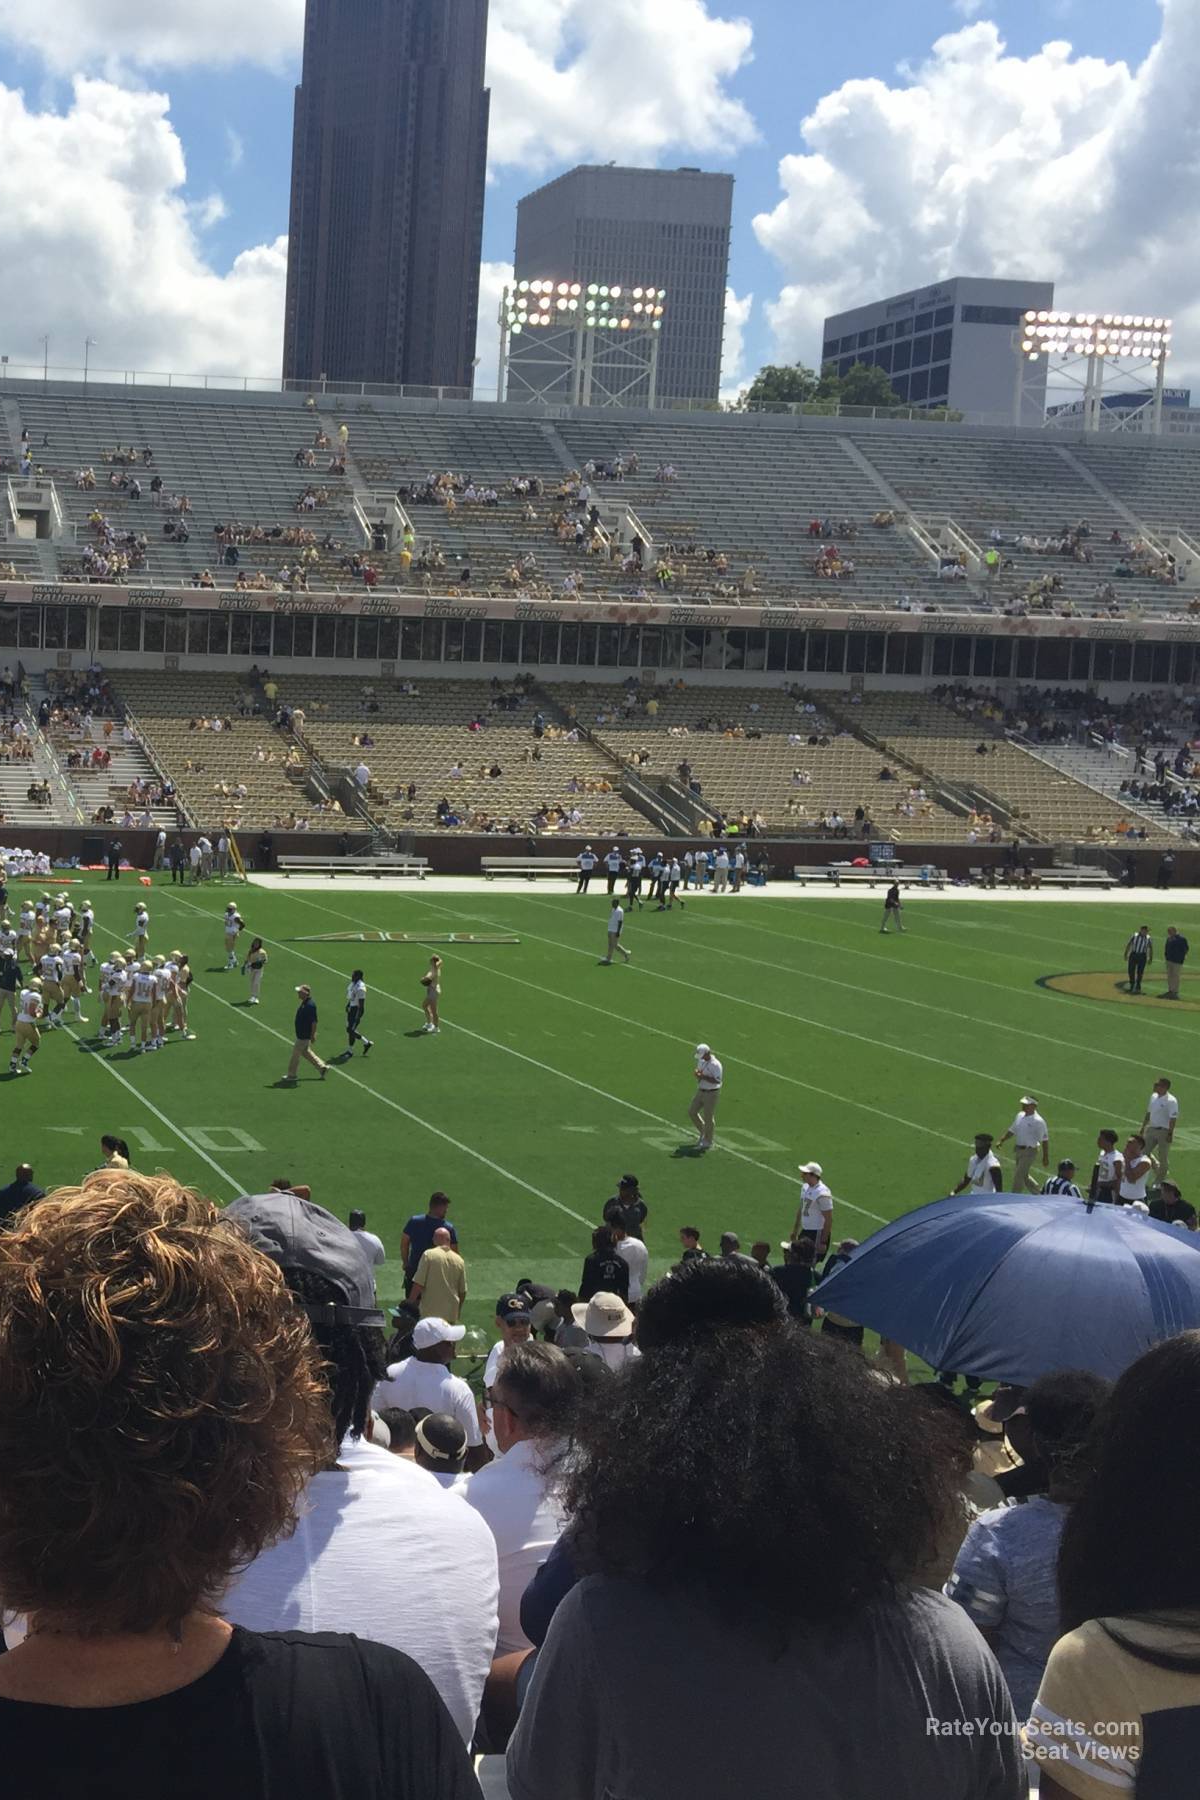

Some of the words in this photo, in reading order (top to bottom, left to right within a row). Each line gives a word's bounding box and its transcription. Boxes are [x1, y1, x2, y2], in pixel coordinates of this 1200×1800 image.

[32, 592, 102, 605] BAUGHAN
[128, 597, 183, 608] MORRIS
[219, 599, 260, 610] DAVIS
[274, 601, 345, 613] HAMILTON
[120, 1126, 267, 1152] 10
[613, 1126, 792, 1152] 20
